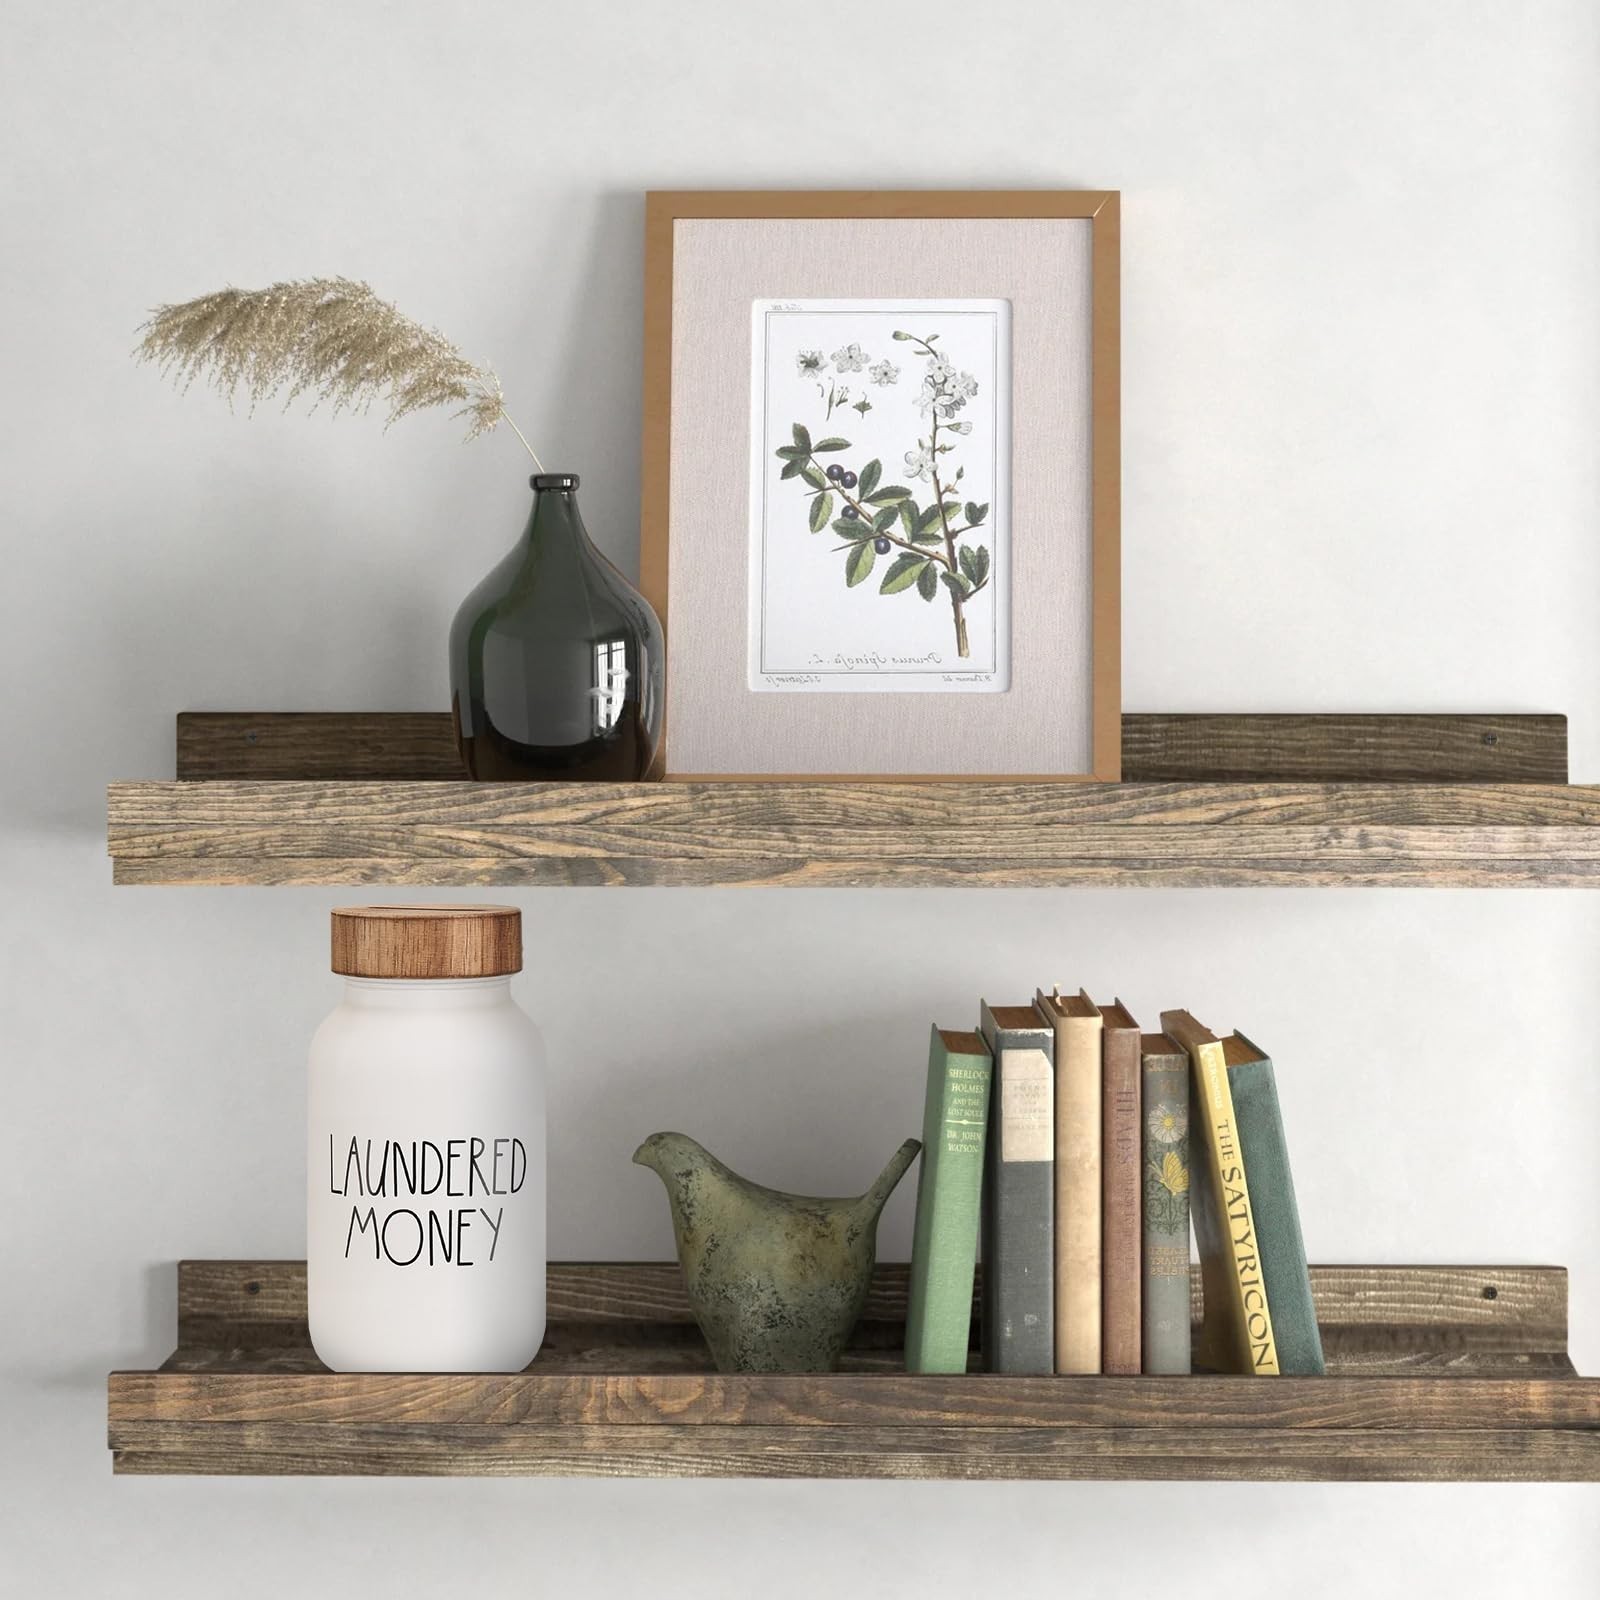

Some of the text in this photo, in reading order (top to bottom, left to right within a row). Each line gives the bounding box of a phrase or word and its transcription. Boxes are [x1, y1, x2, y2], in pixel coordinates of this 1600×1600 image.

[949, 1068, 989, 1080] SHERLOCK
[951, 1082, 984, 1094] HOLMES
[961, 1131, 982, 1142] JOHN
[948, 1143, 979, 1153] WATSON
[330, 1134, 526, 1197] LAUNDERED
[345, 1206, 503, 1266] MONEY
[1217, 1120, 1273, 1368] THE SATYRICON
